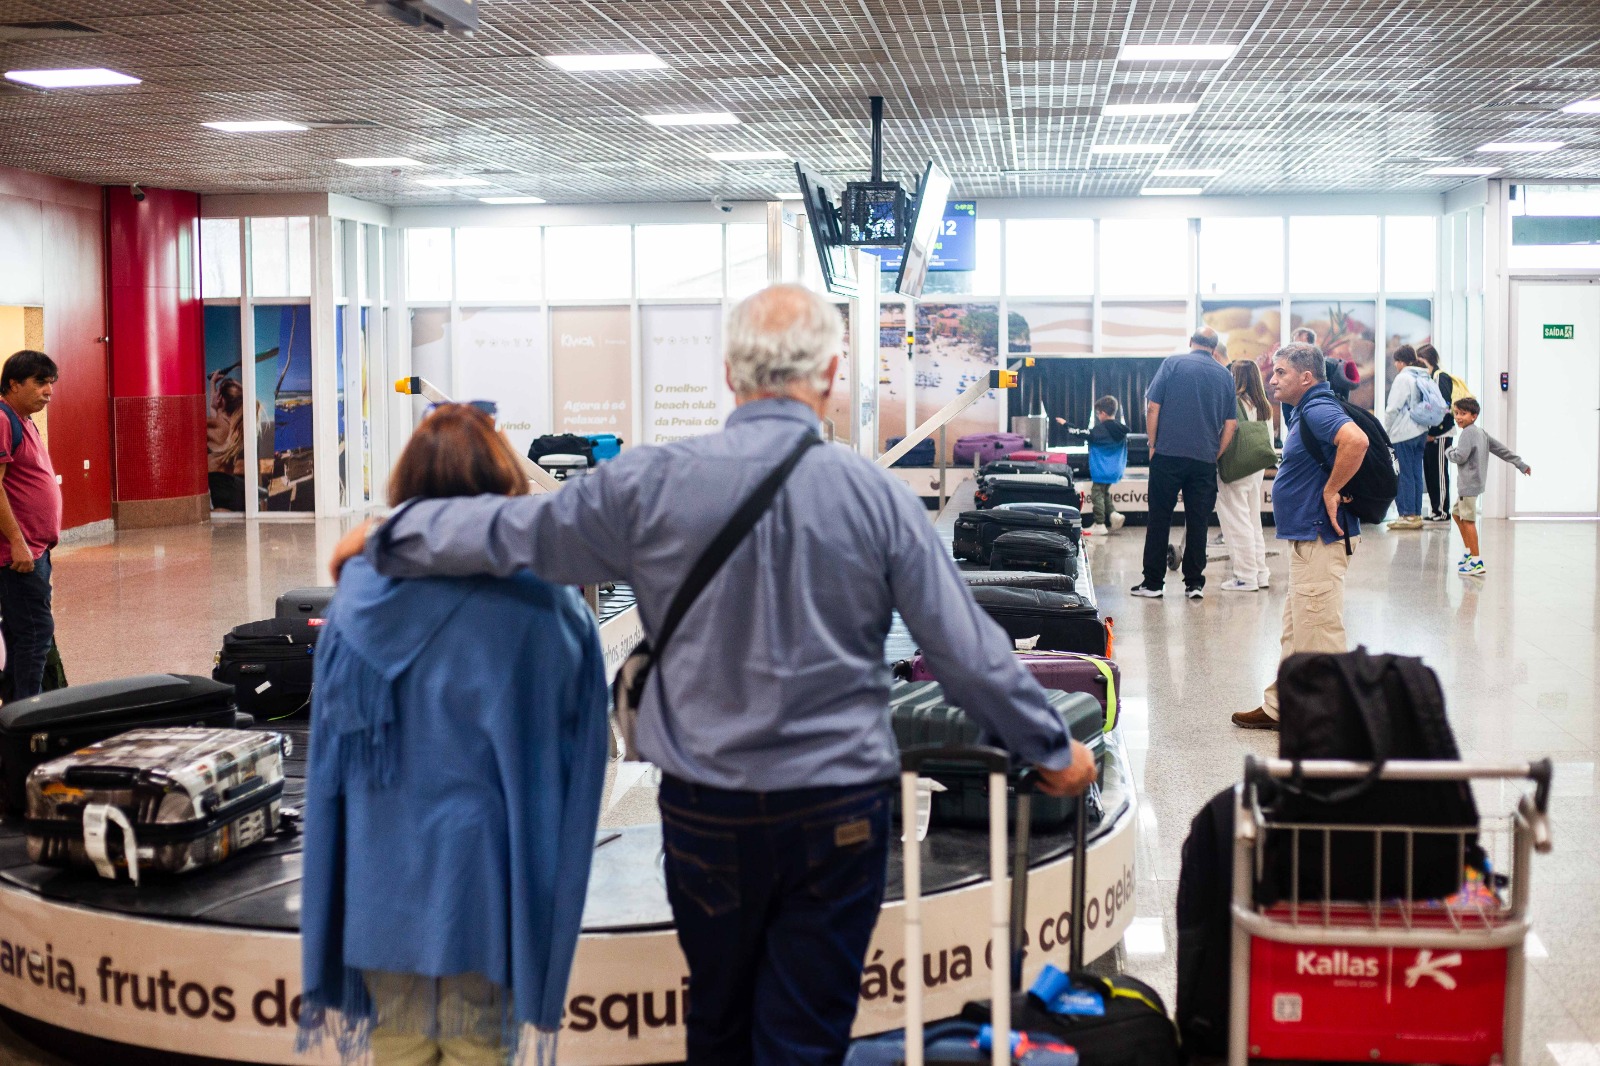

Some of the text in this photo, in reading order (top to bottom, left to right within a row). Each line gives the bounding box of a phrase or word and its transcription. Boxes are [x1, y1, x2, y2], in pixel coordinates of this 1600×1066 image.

[1544, 326, 1564, 337] SAÍDA
[654, 384, 708, 393] O melhor
[563, 400, 601, 412] Agora
[654, 400, 717, 410] beach club
[655, 417, 719, 426] da Praia do
[0, 938, 87, 1006] areia,
[96, 956, 236, 1023] frutos
[1039, 897, 1100, 952] coo
[1296, 950, 1379, 977] Kallas
